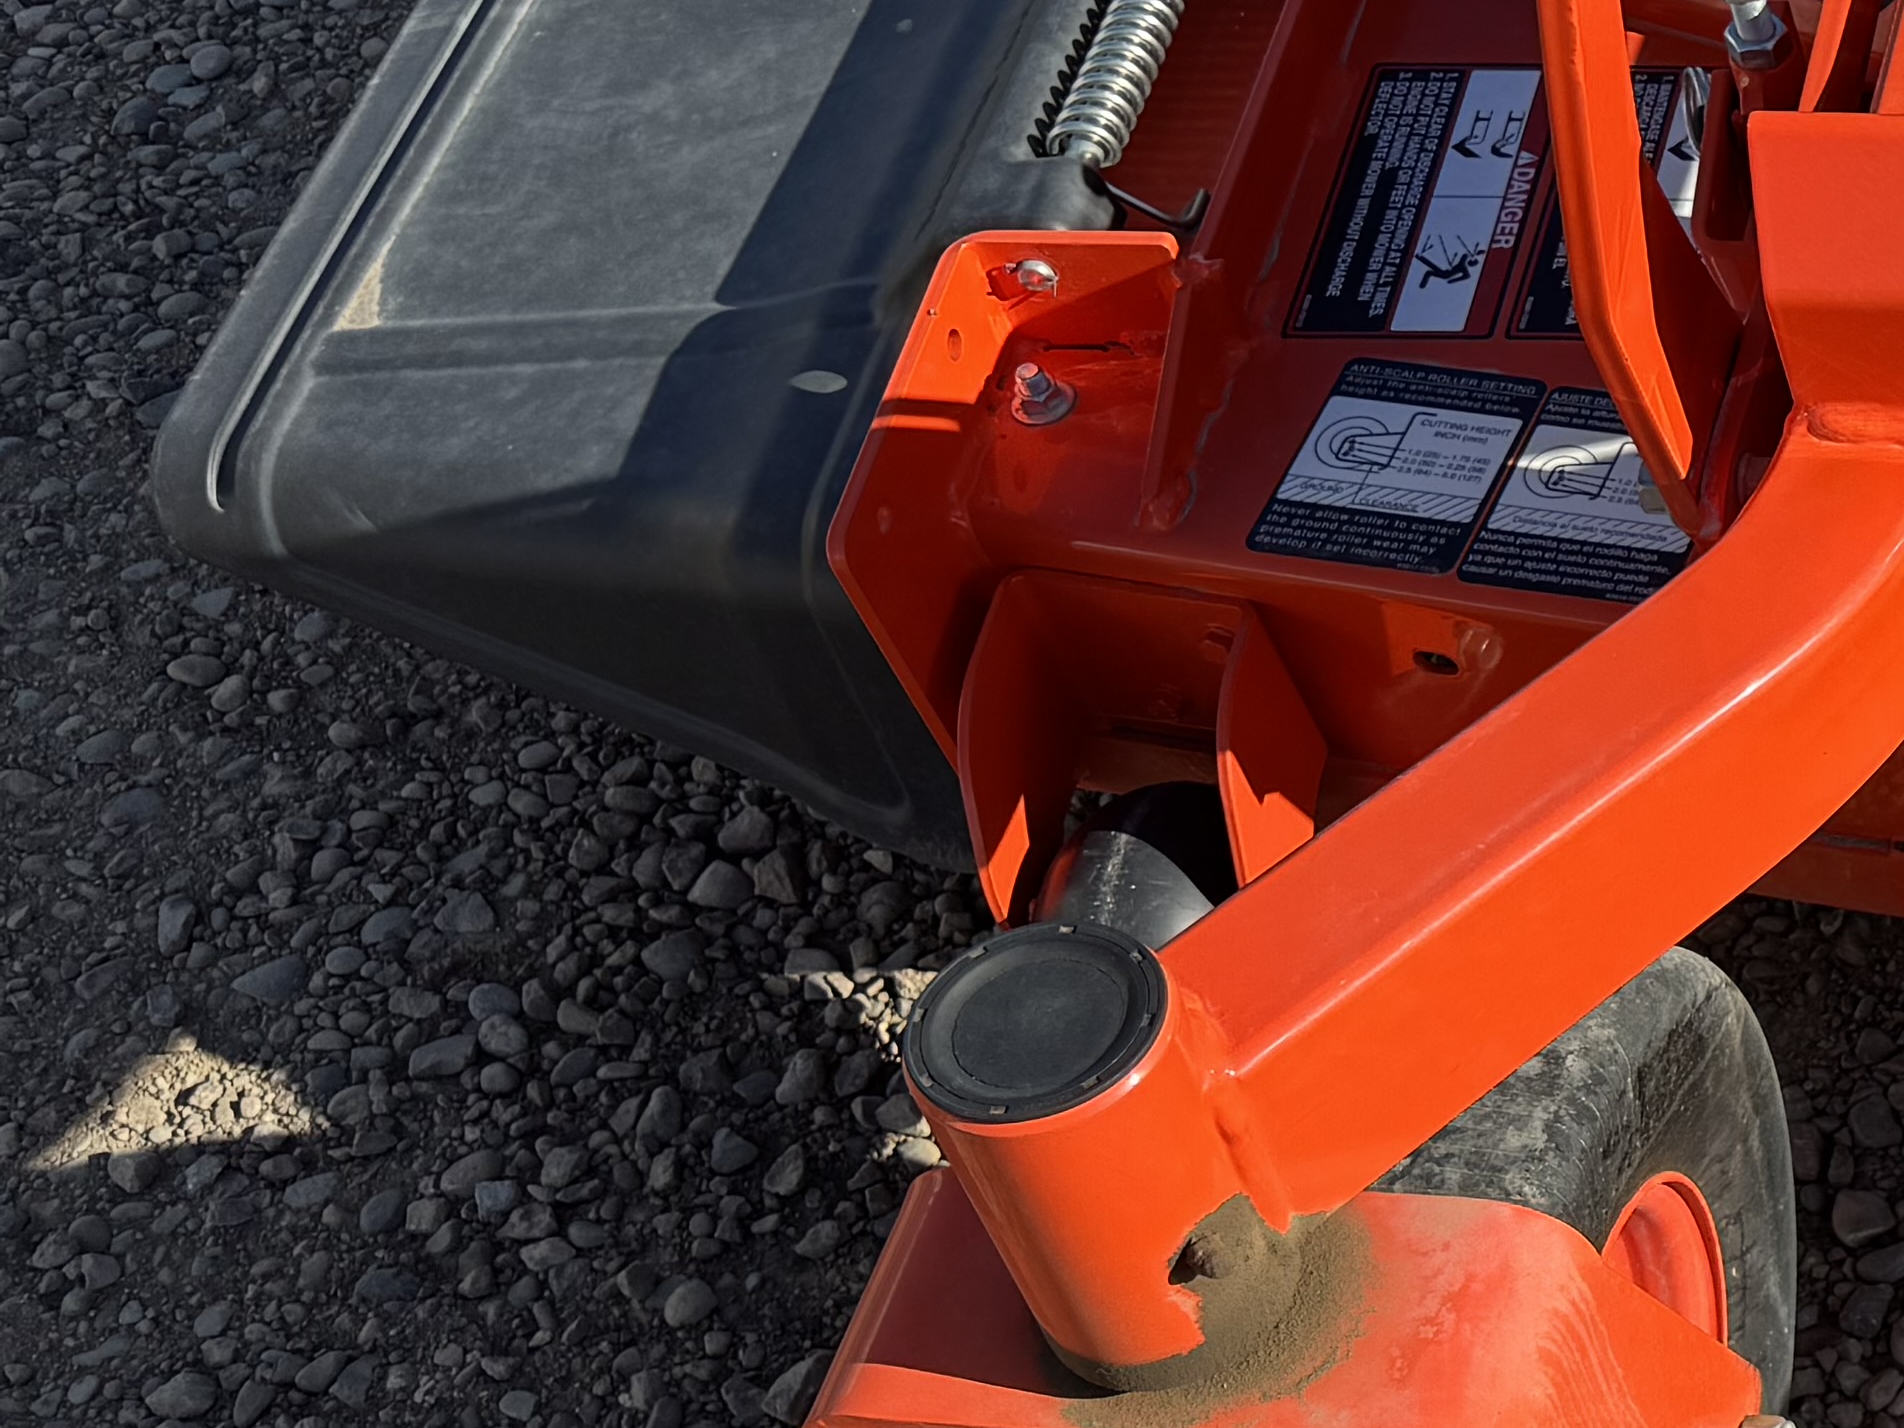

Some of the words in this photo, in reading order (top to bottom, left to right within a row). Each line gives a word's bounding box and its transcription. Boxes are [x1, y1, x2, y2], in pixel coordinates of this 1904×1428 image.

[1492, 167, 1537, 250] DANGER
[1350, 363, 1426, 380] ANTI-SCALP
[1428, 373, 1478, 388] ROLLER
[1480, 378, 1538, 395] SETTING
